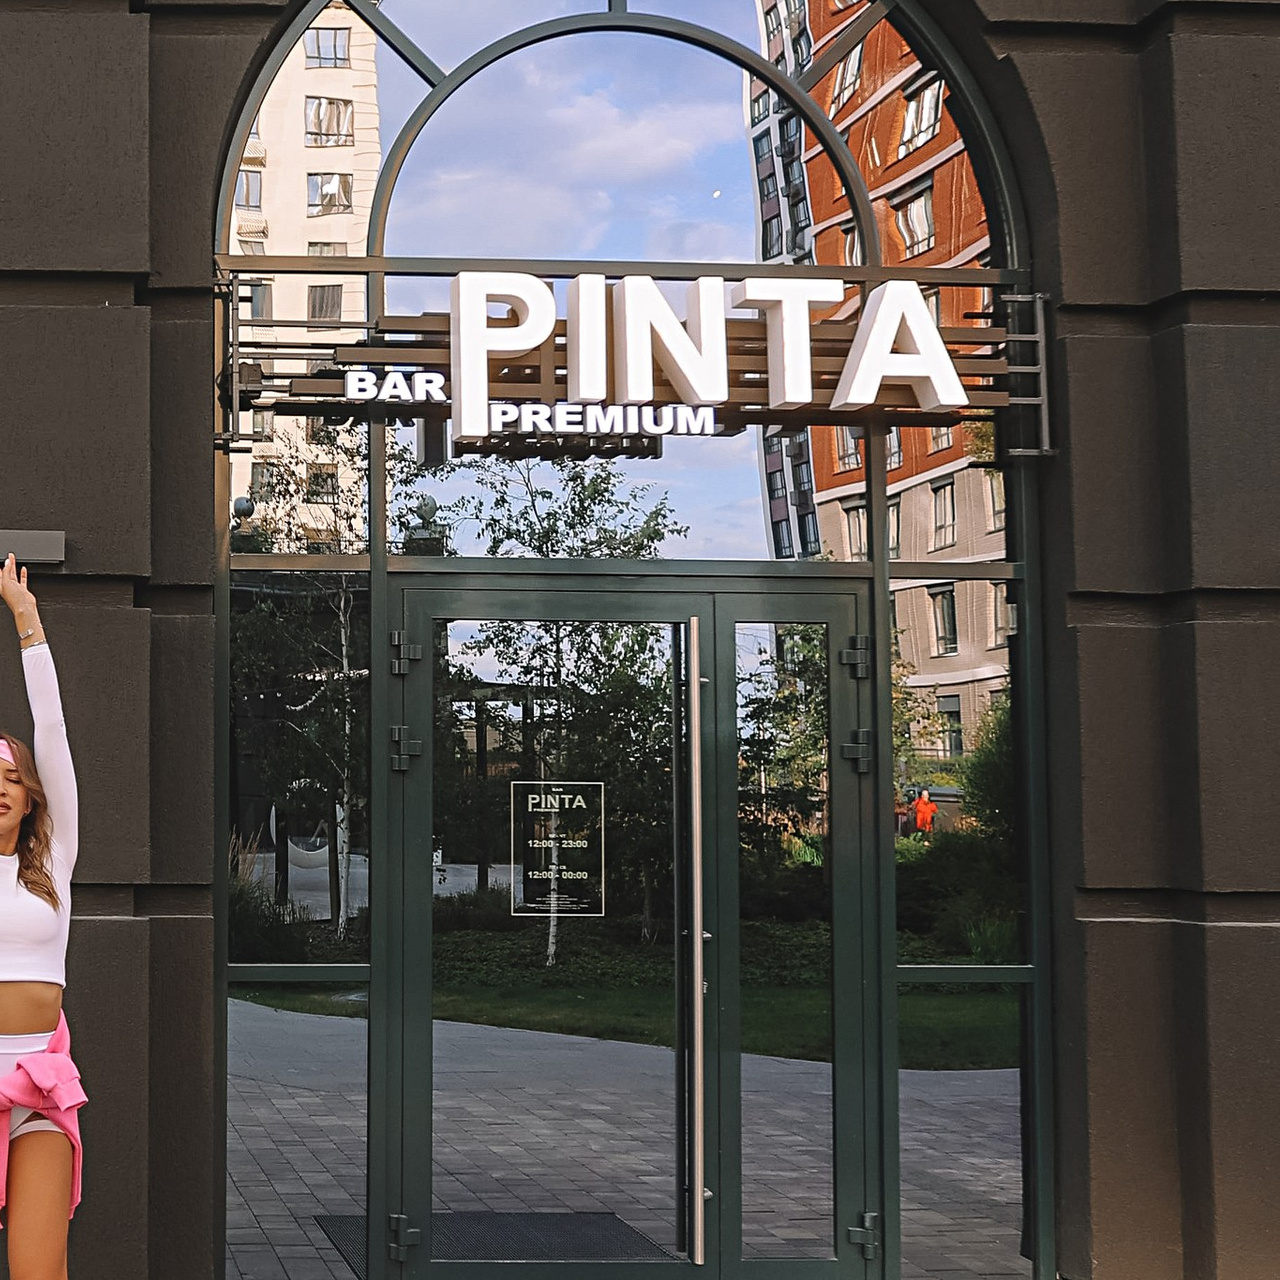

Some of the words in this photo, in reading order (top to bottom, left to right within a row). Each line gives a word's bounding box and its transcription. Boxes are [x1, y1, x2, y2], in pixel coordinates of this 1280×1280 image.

[450, 271, 969, 442] PINTA
[345, 370, 447, 401] BAR
[489, 403, 717, 435] PREMIUM
[528, 794, 587, 812] PINTA
[527, 839, 554, 848] 12:00
[561, 839, 588, 848] 23:00
[527, 870, 554, 879] 12:00
[561, 870, 588, 879] 00:00
